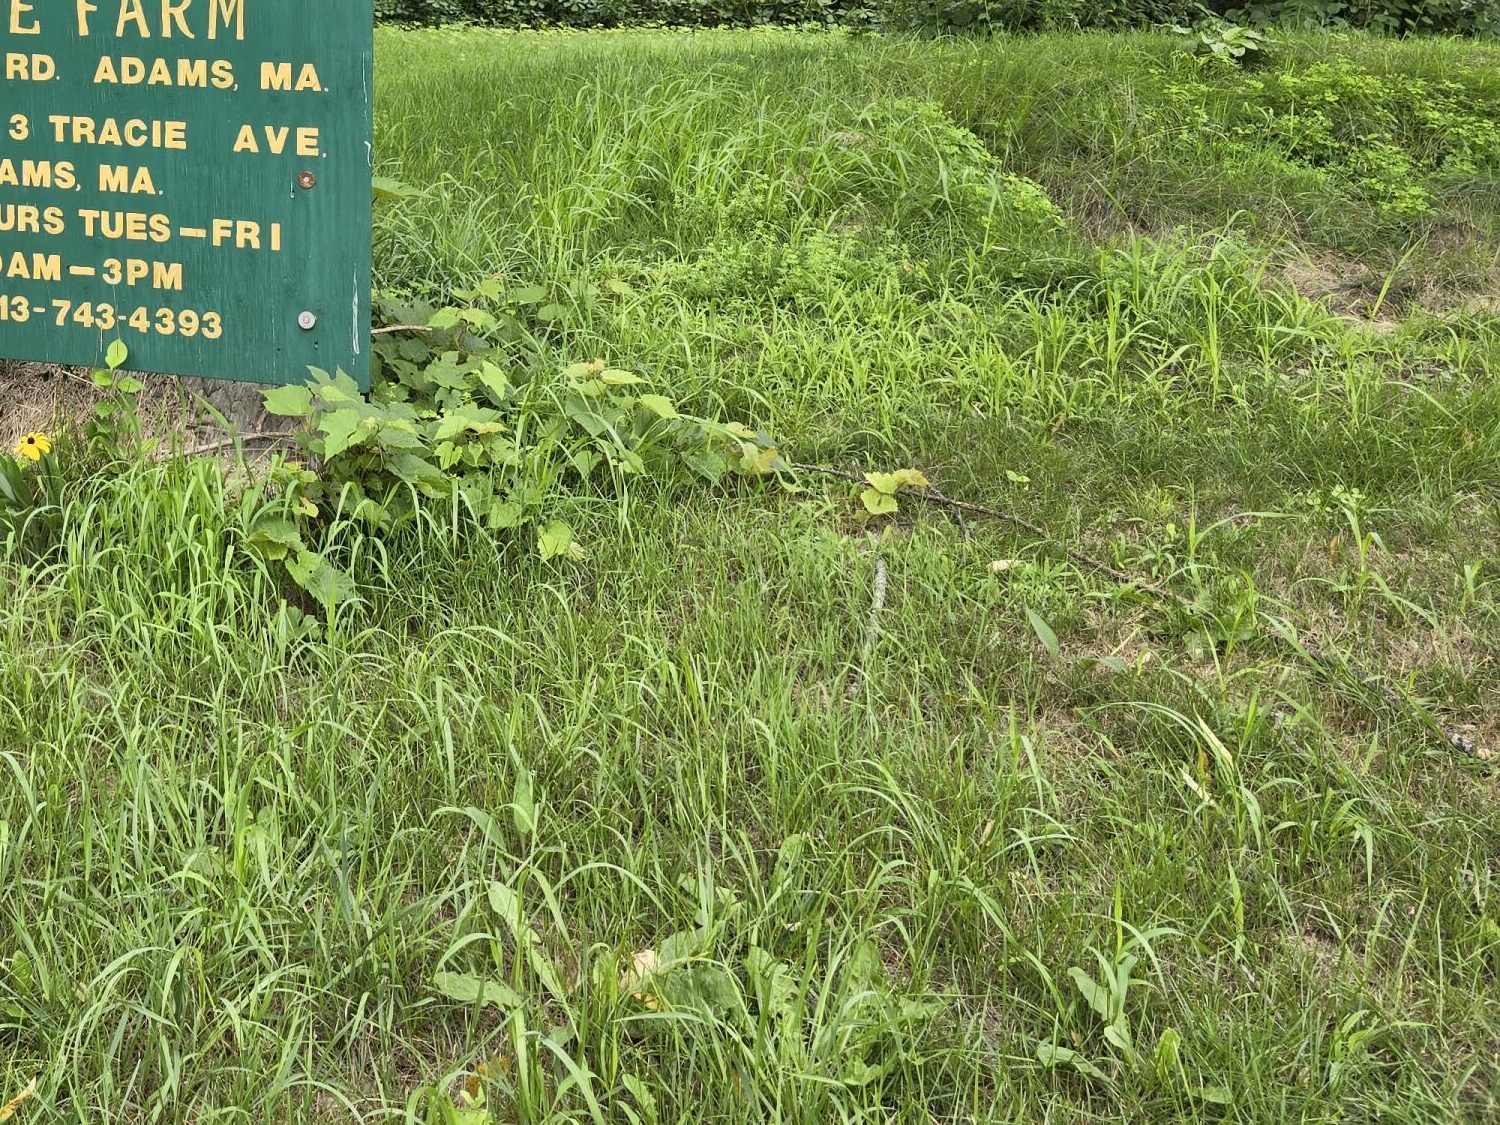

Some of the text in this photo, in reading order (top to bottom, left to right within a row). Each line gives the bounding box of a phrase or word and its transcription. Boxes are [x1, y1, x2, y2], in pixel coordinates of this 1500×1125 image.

[6, 52, 60, 82] RD.
[94, 56, 238, 90] ADAMS,
[261, 62, 329, 92] MA.
[9, 114, 29, 140] 3
[49, 116, 186, 149] TRACIE
[99, 165, 163, 195] MA.
